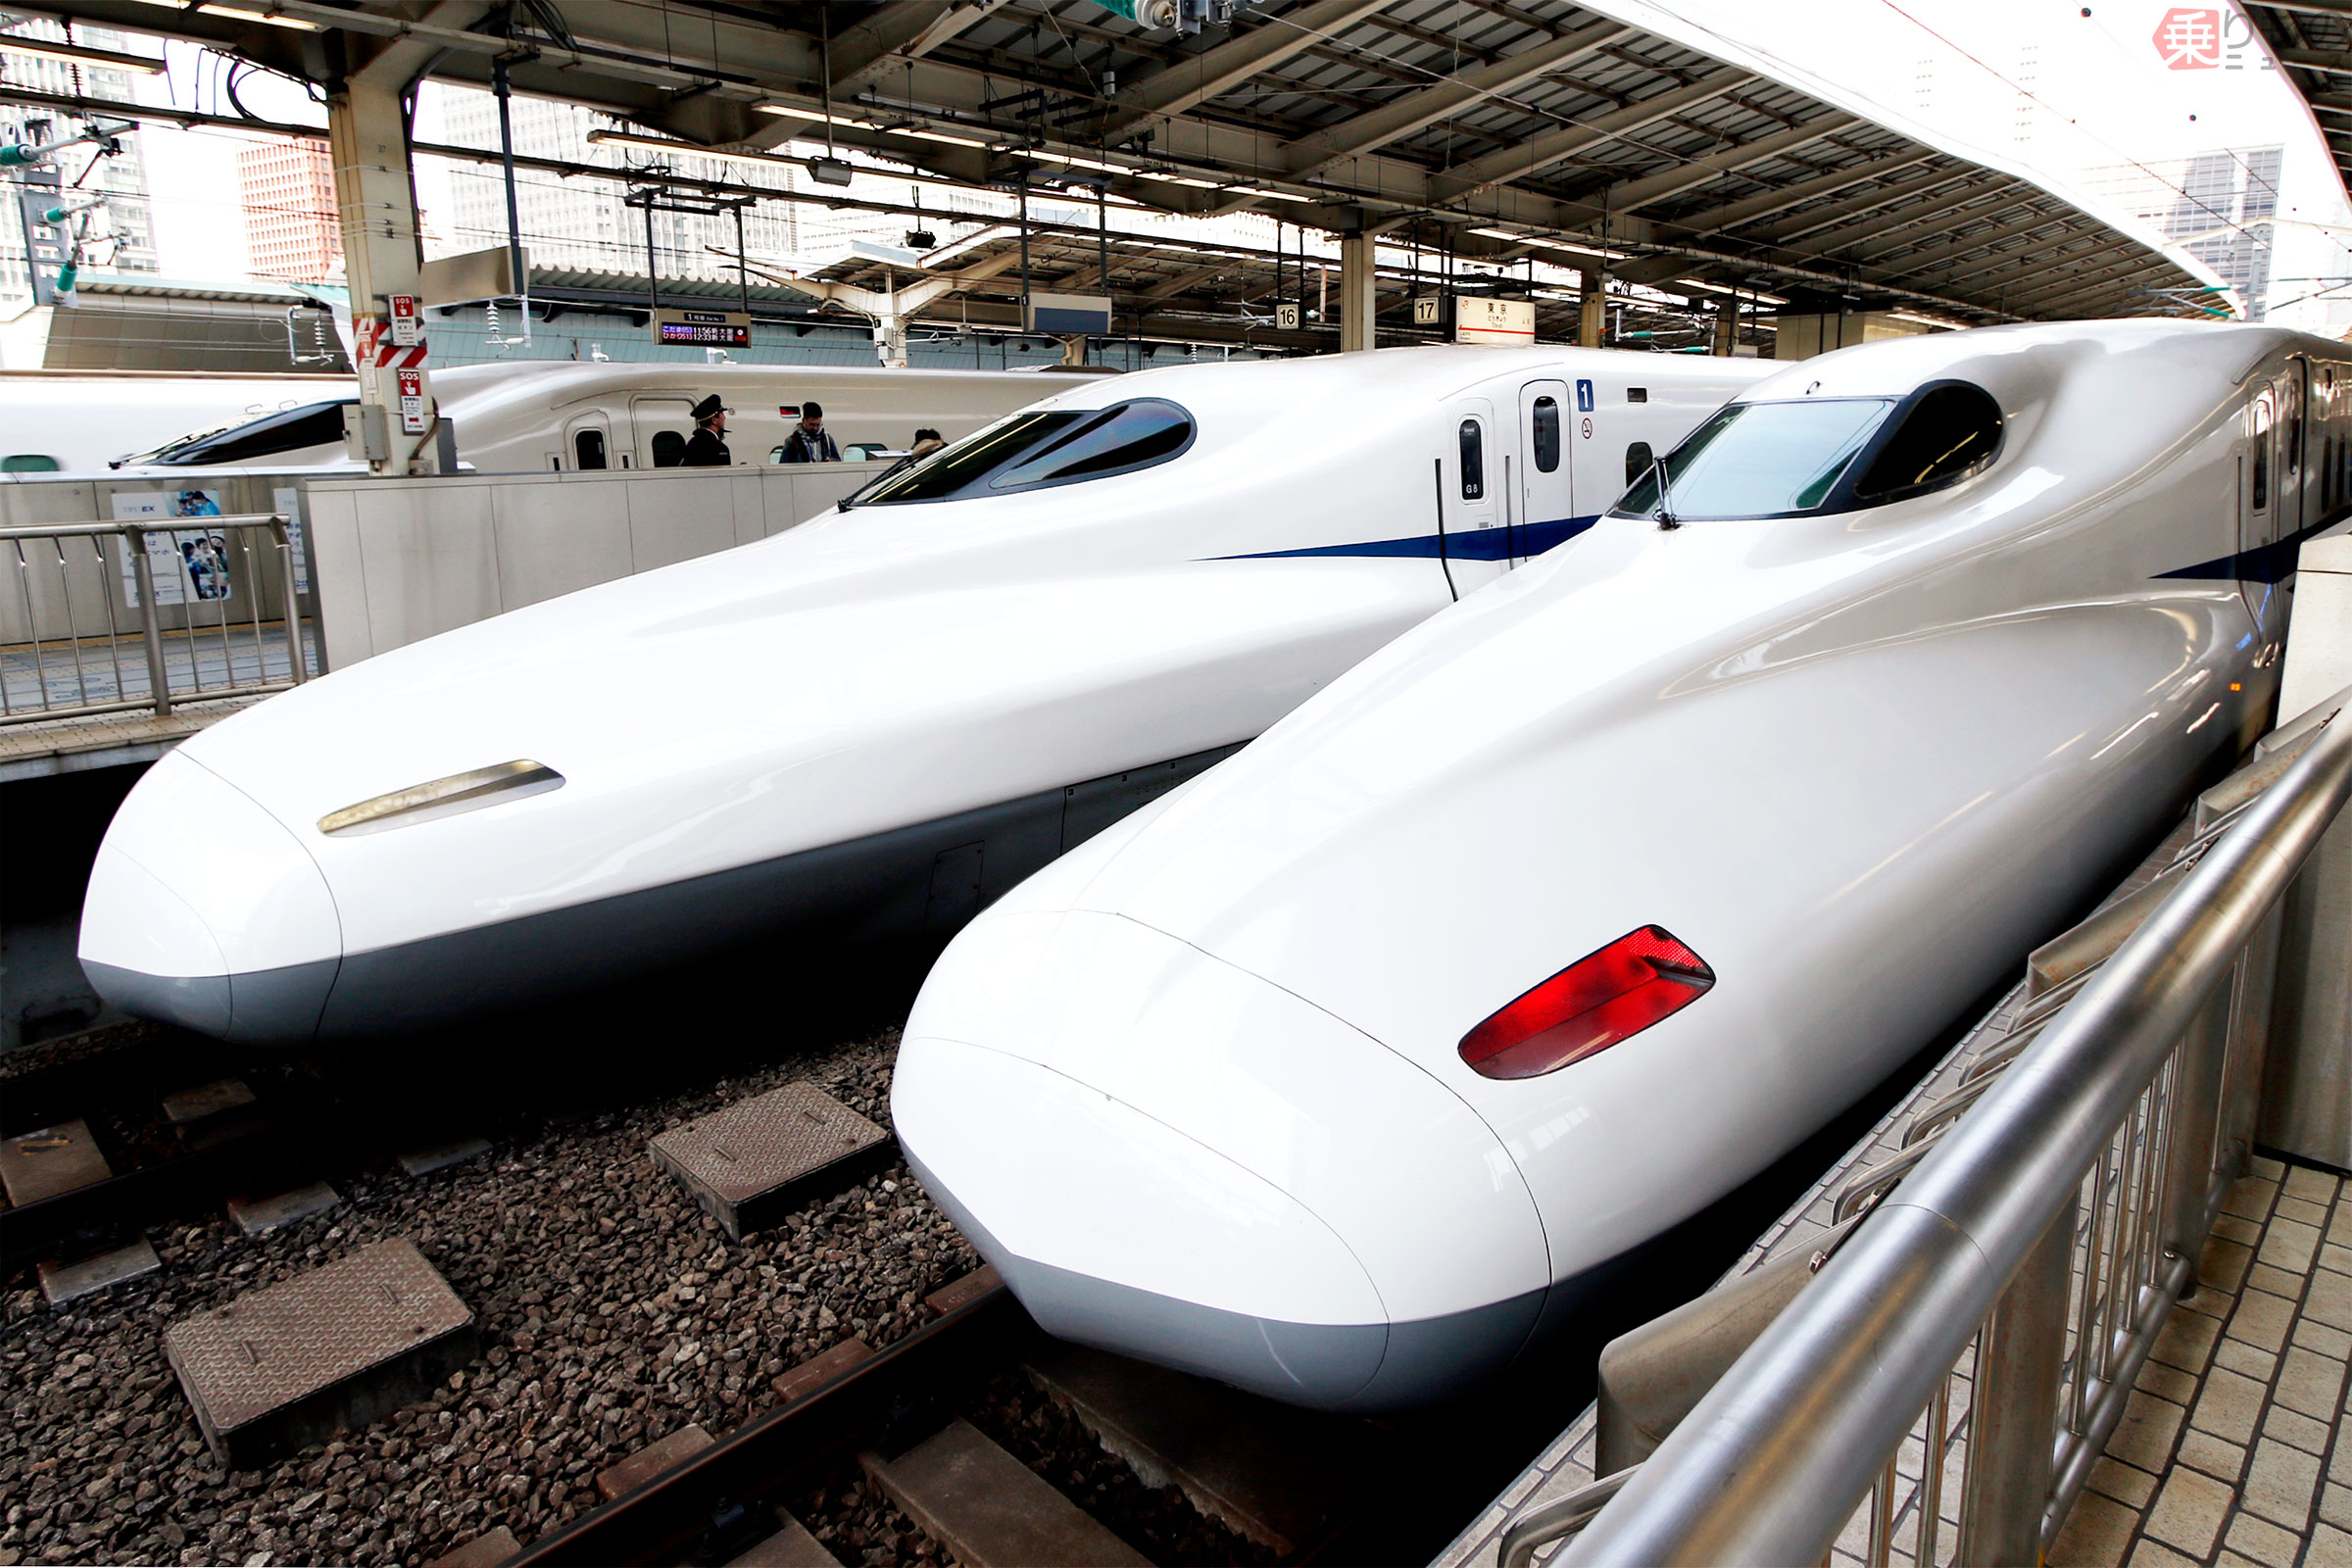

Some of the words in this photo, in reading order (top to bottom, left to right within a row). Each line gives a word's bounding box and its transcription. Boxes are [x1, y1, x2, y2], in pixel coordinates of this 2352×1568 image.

[1418, 302, 1435, 318] 17
[1488, 302, 1507, 315] 東京
[1280, 309, 1296, 325] 16
[399, 371, 419, 380] SOS
[1581, 383, 1589, 409] 1
